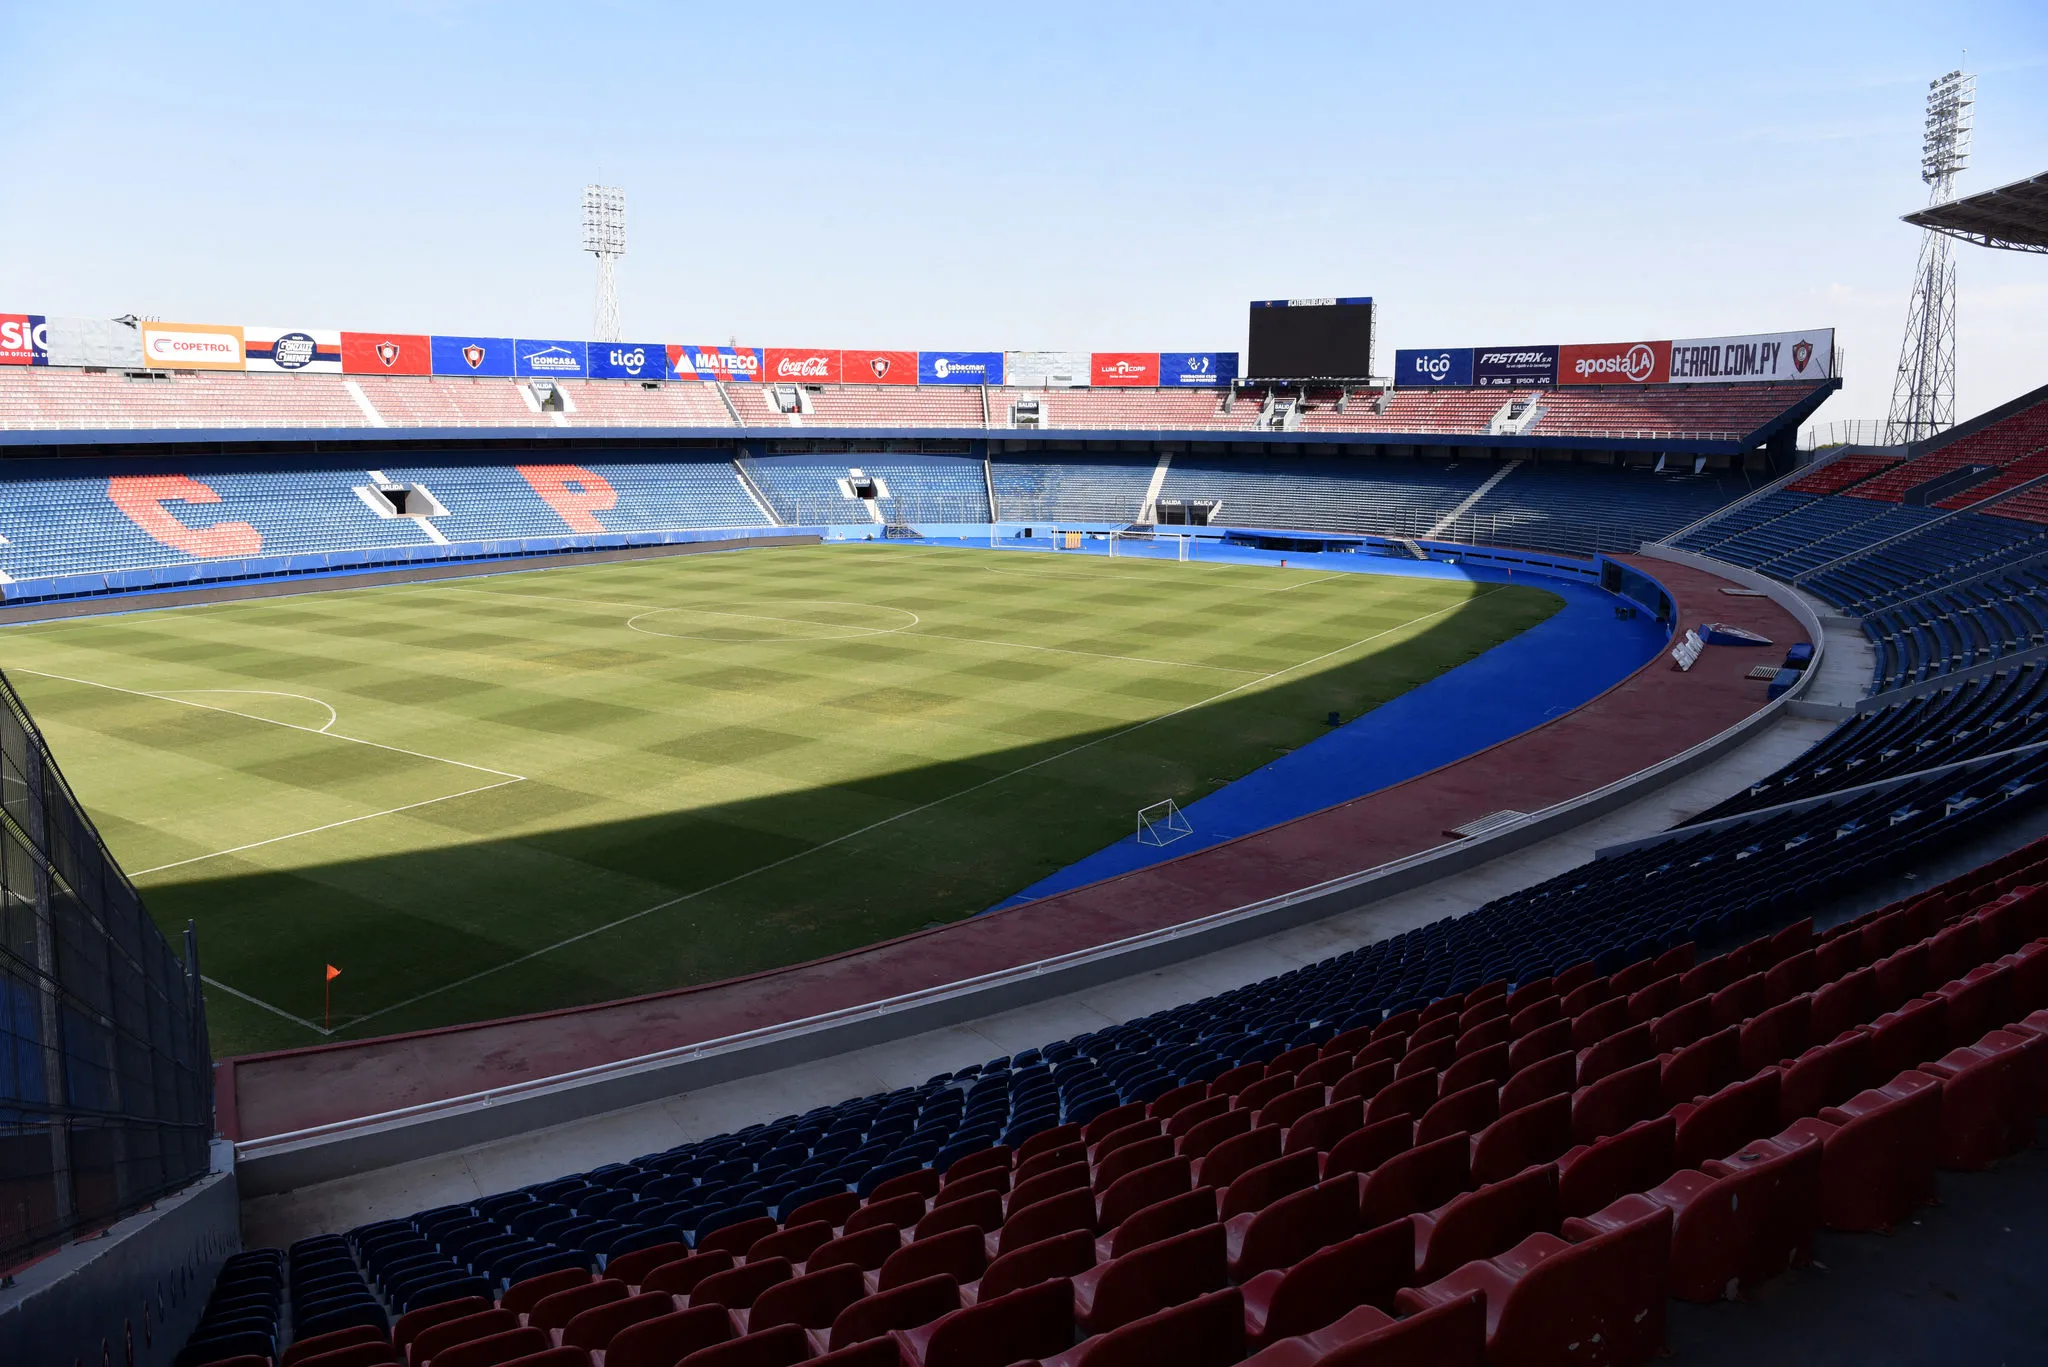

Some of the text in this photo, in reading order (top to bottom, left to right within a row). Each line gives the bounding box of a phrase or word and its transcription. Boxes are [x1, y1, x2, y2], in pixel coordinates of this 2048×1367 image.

[173, 341, 232, 353] COPETROL
[534, 356, 577, 365] CONCASA
[696, 353, 758, 369] MATECO
[1480, 352, 1544, 364] FASTRAX
[1670, 341, 1782, 377] CERRO.COM.PY
